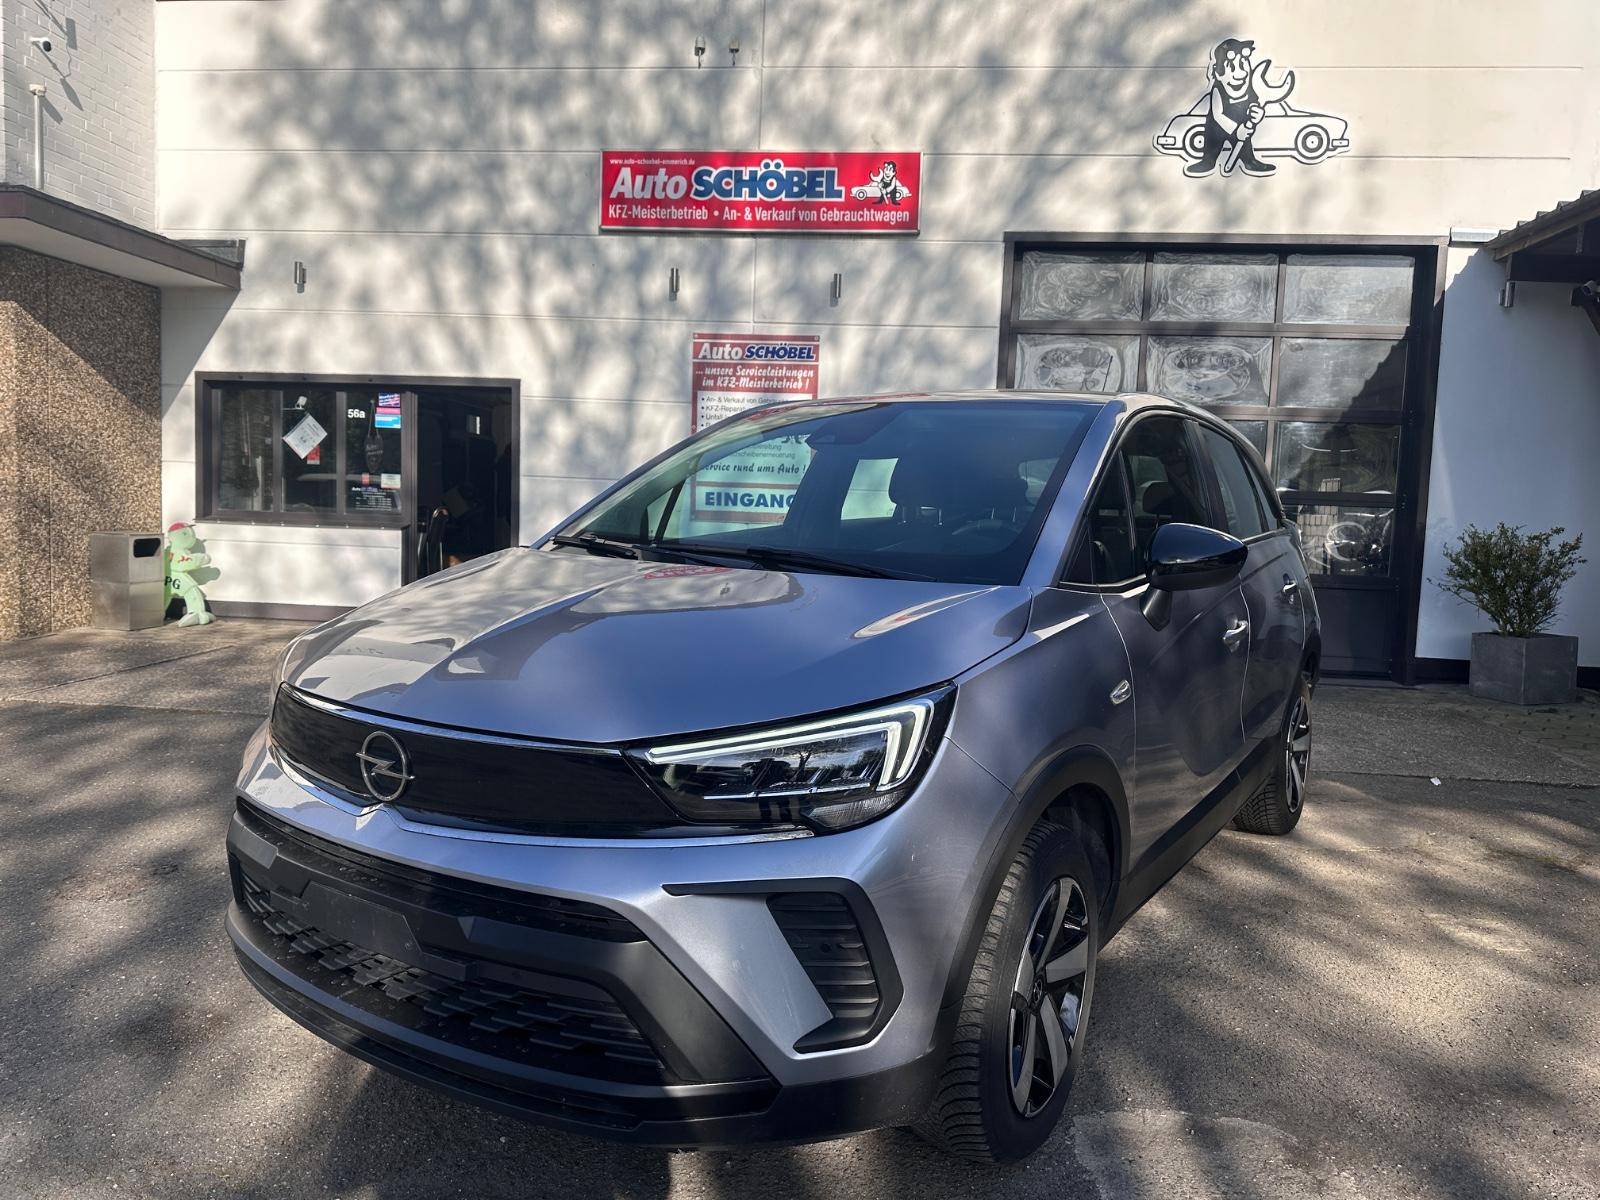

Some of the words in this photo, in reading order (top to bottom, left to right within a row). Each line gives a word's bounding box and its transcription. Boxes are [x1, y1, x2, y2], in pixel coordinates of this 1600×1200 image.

[609, 166, 688, 199] Auto
[690, 159, 845, 201] SCHÖBEL
[608, 204, 708, 220] KFZ-Meisterbetrieb
[723, 207, 741, 221] An-
[744, 207, 752, 221] &
[755, 207, 796, 221] Verkauf
[799, 211, 817, 221] von
[820, 208, 910, 224] Gebrauchtwagen
[698, 342, 743, 360] Auto
[745, 342, 816, 360] SCHÖBEL
[705, 367, 734, 375] unsere
[736, 365, 814, 379] Serviceleistungen
[702, 377, 714, 387] im
[716, 376, 802, 389] KFZ-Meisterbetrieb
[347, 408, 366, 419] 56a
[703, 463, 730, 472] ervice
[733, 463, 754, 473] rund
[757, 465, 775, 473] ums
[777, 463, 800, 475] Auto
